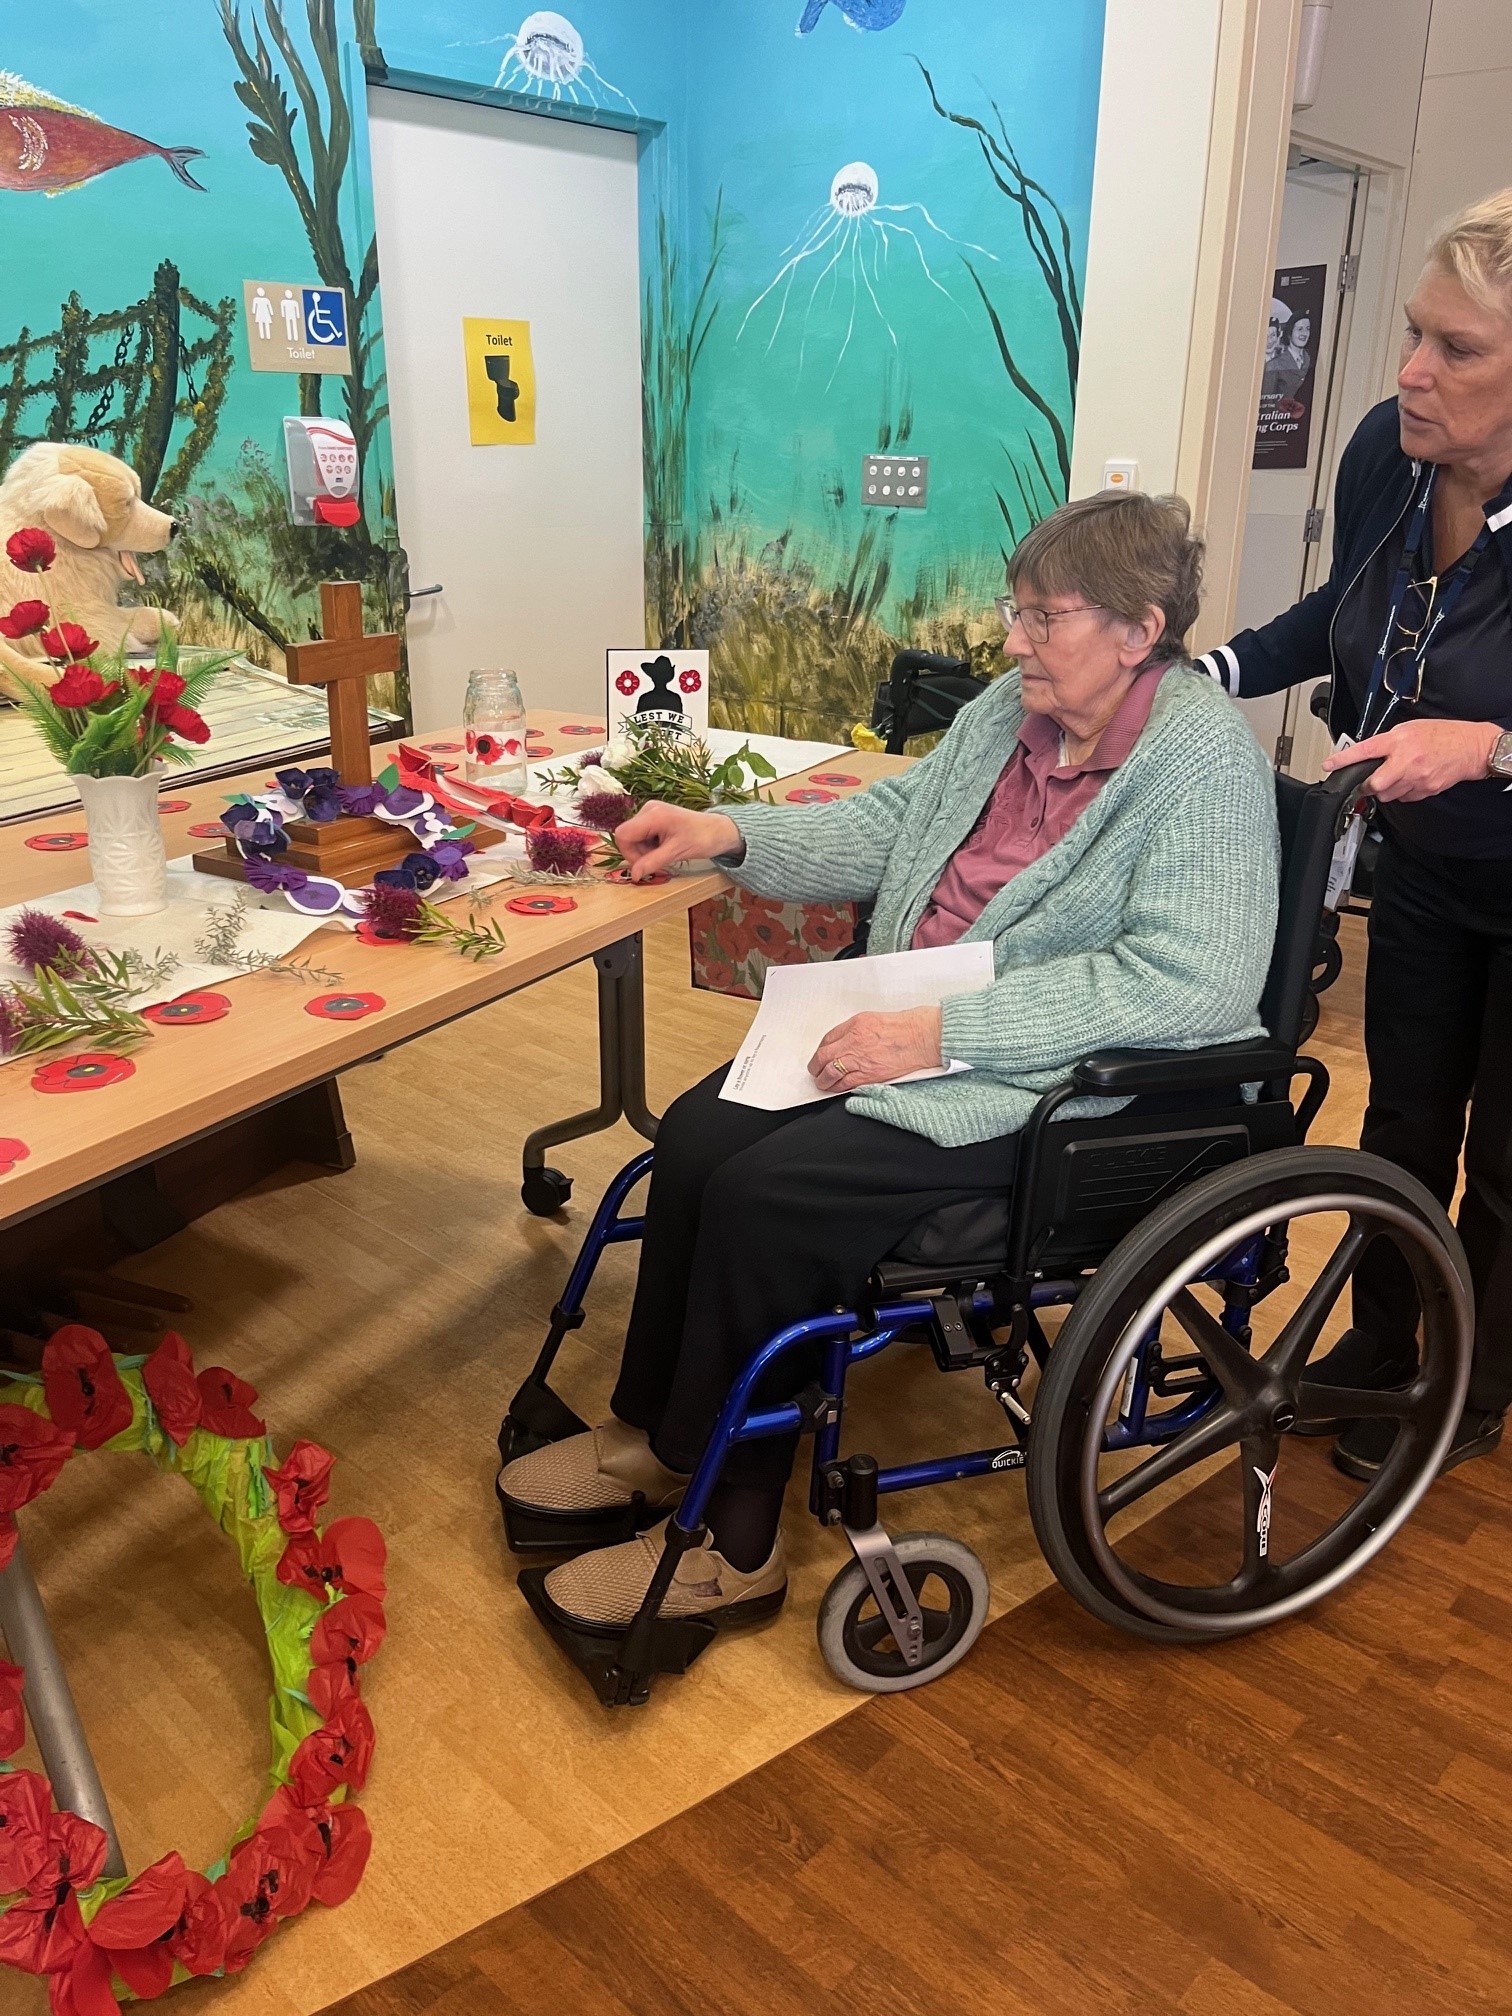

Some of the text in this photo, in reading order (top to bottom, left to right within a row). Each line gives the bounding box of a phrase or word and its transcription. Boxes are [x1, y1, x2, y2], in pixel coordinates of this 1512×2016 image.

[486, 334, 513, 346] Toilet
[286, 347, 315, 360] Toilet
[1261, 393, 1284, 402] rsary
[1260, 410, 1291, 420] ralian
[1257, 421, 1299, 434] ng Corps
[633, 711, 685, 724] LEST WE
[991, 1456, 1025, 1469] QUICKIE
